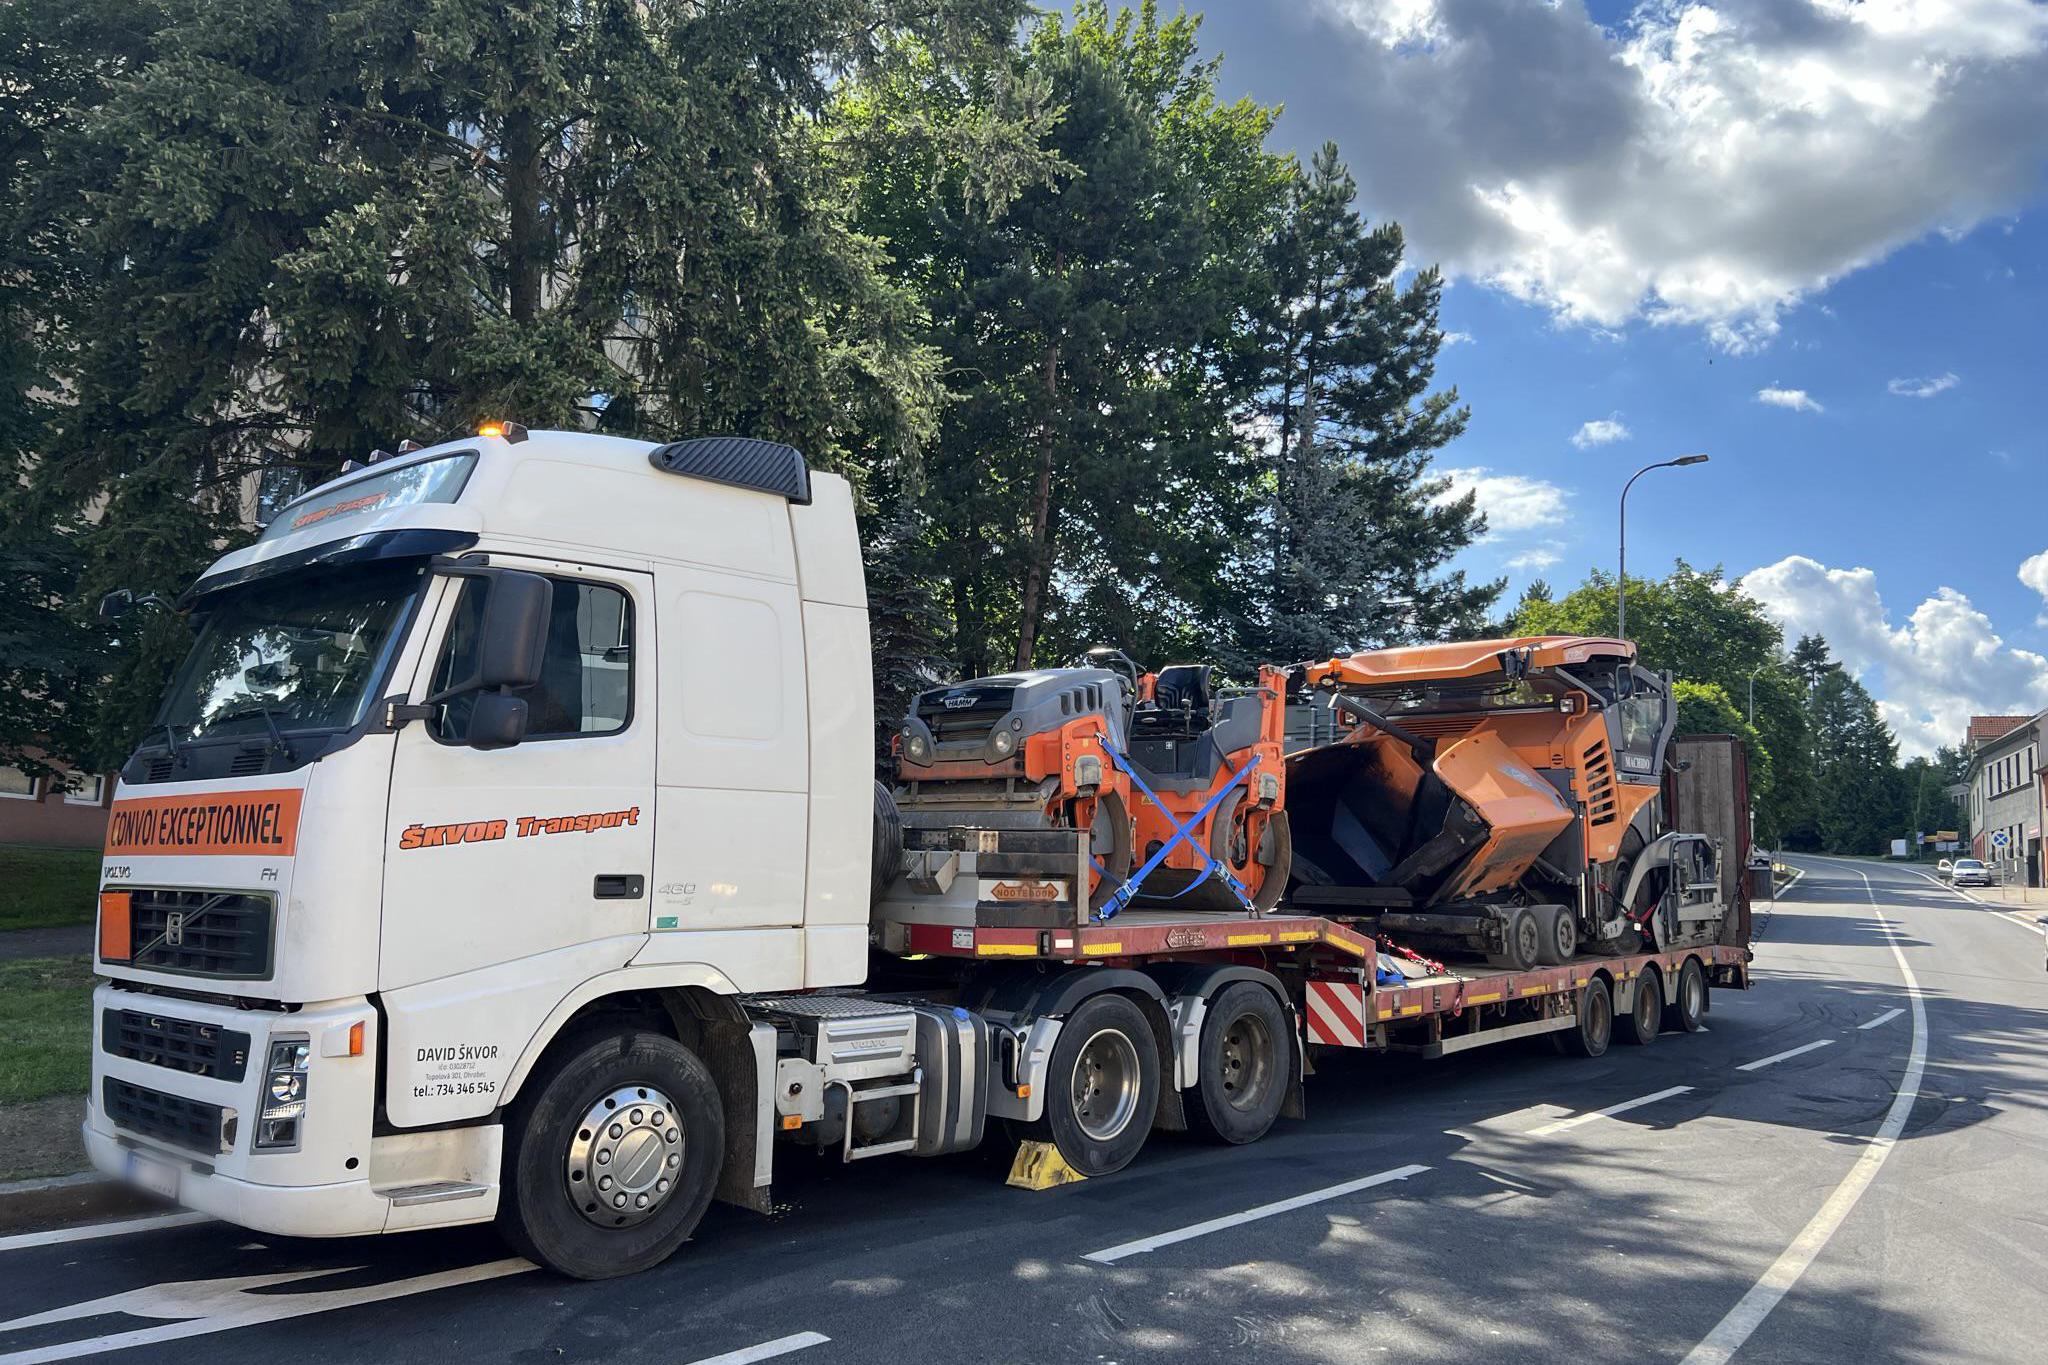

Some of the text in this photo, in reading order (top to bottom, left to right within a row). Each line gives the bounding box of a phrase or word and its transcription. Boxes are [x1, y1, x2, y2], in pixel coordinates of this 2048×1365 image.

[948, 699, 972, 707] HAMM
[111, 803, 283, 847] CONVOI EXCEPTIONNEL
[399, 806, 640, 850] ŠKVOR Transport
[104, 865, 279, 881] VOLVO FH
[997, 888, 1055, 898] NOOTEBOOM
[417, 1043, 498, 1062] DAVID ŠKVOR
[849, 1039, 889, 1050] VOLVO
[413, 1081, 495, 1098] tel.: 734 346 545
